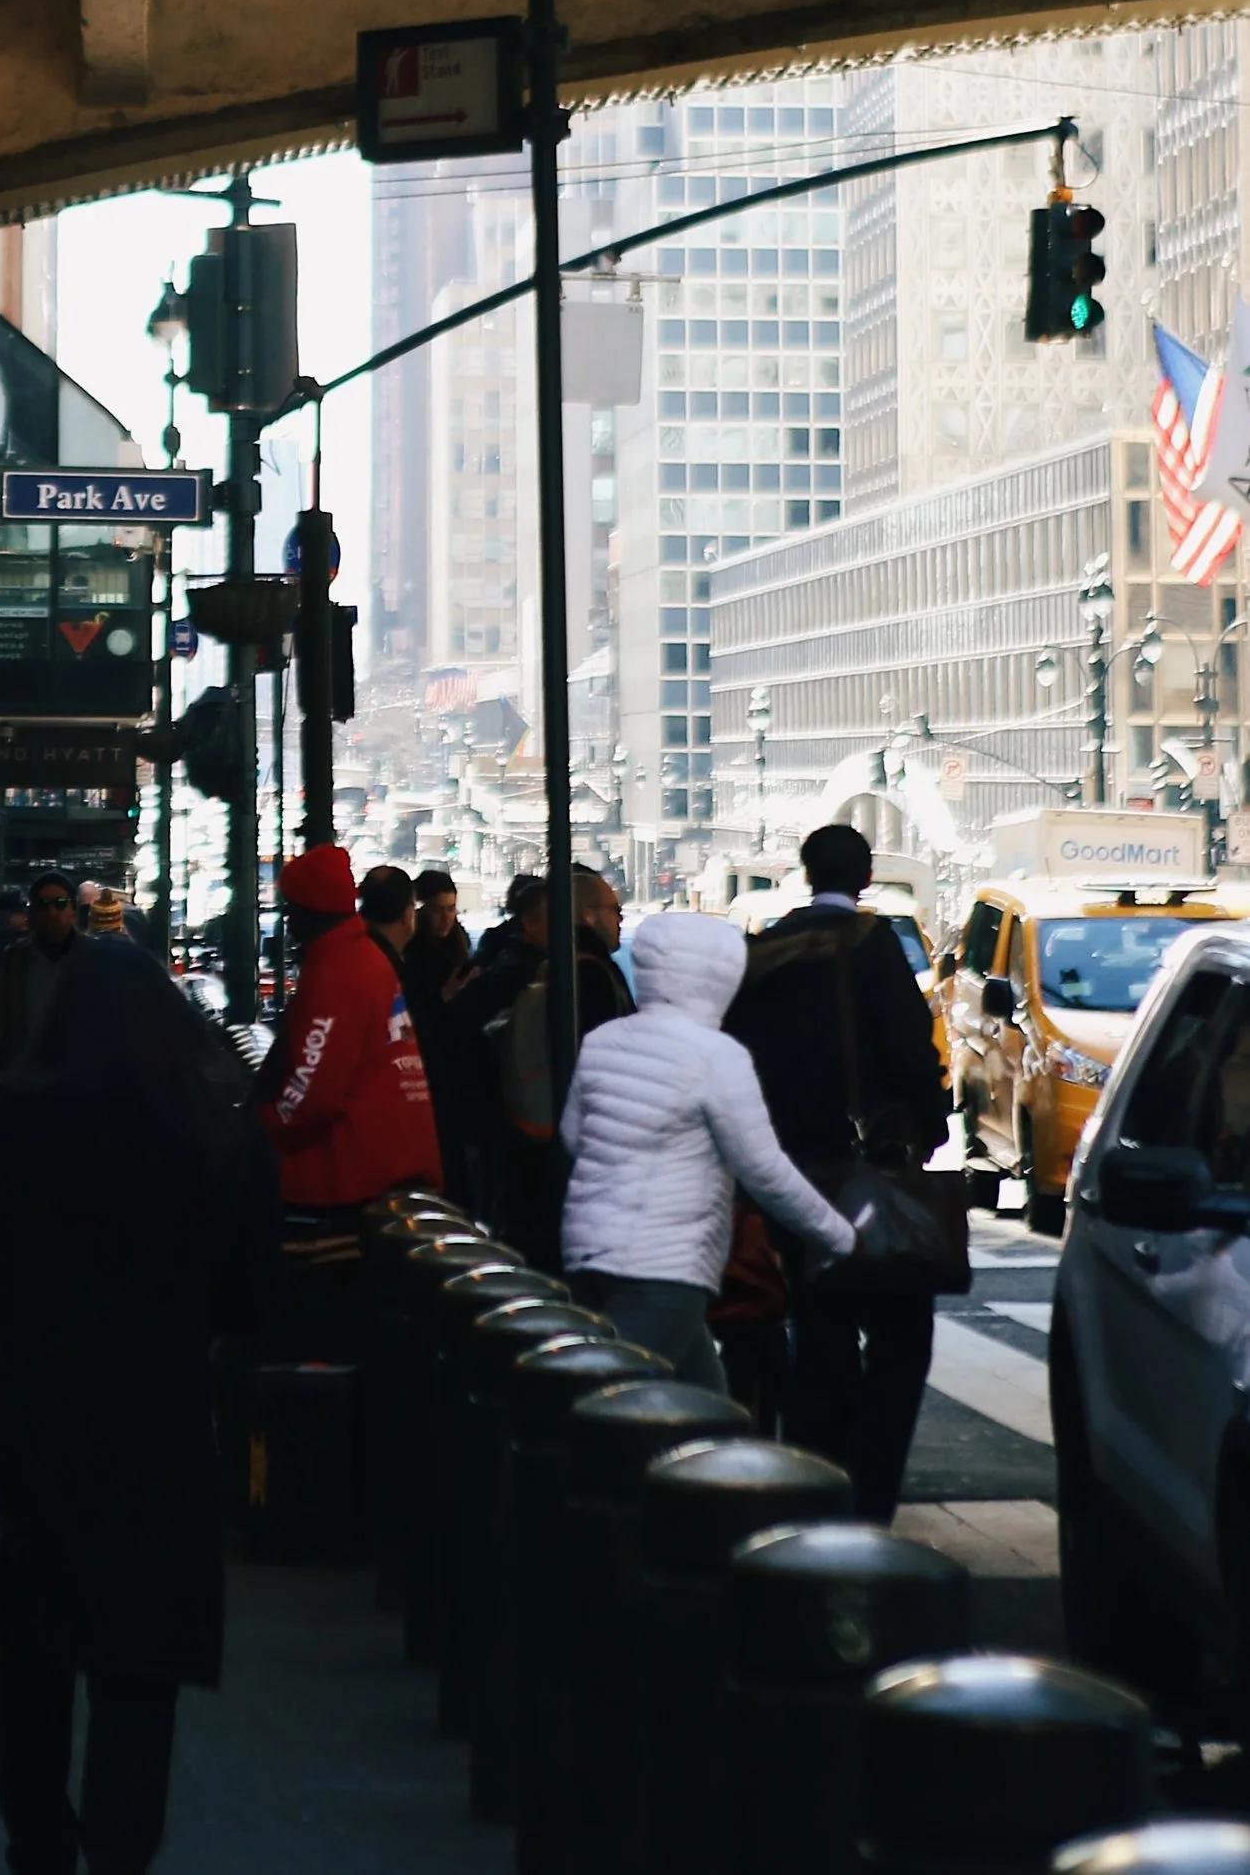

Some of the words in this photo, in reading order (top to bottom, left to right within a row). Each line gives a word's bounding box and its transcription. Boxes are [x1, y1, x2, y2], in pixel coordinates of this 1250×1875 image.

[36, 484, 104, 510] Park
[111, 485, 167, 511] Ave
[42, 746, 123, 762] HYATT
[1060, 839, 1181, 866] GoodMart
